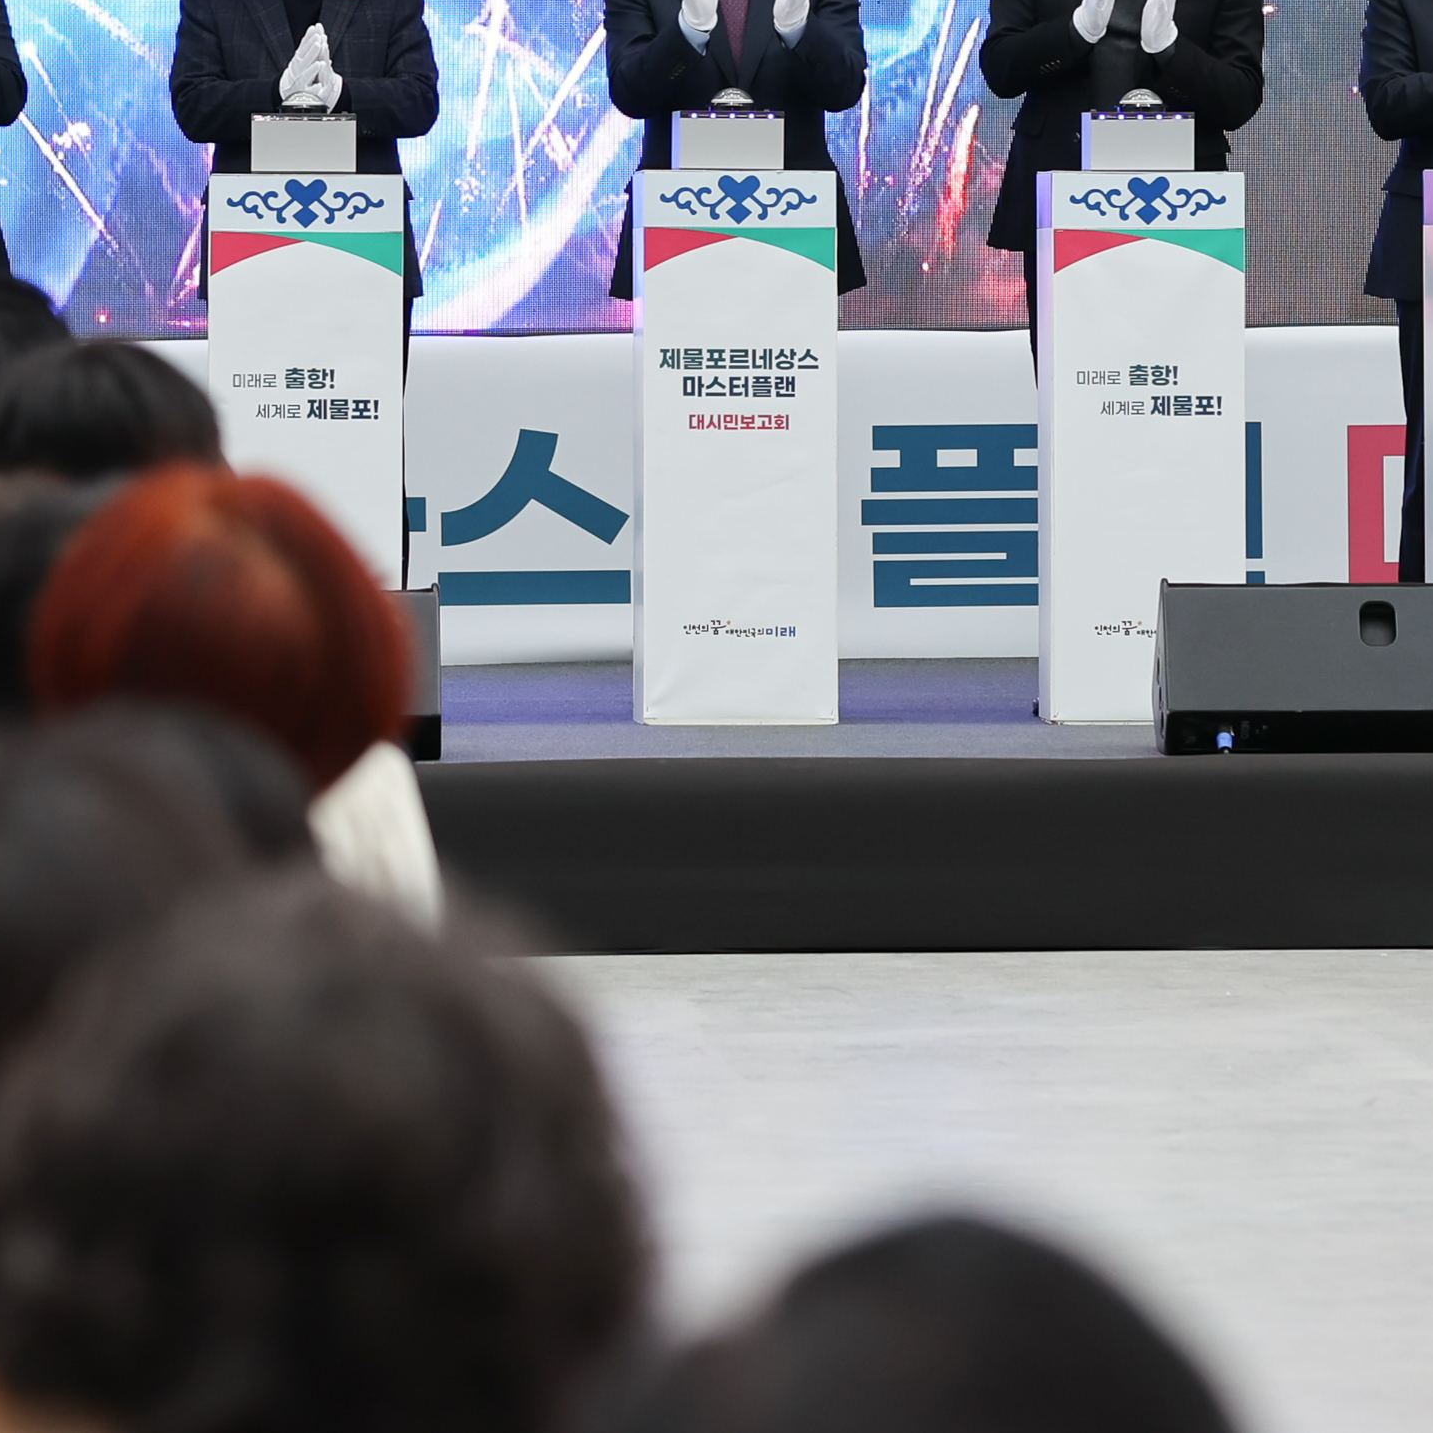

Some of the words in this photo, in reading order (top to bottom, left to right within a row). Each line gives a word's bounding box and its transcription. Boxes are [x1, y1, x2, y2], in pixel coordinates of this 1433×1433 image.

[659, 348, 819, 370] 제물포르네상스
[232, 373, 278, 389] 미래로
[284, 367, 336, 390] 출항!
[1076, 370, 1122, 386] 미래로
[1128, 364, 1179, 386] 출항!
[682, 375, 796, 398] 마스터플랜
[255, 404, 301, 419] 세계로
[306, 398, 380, 420] 제물포!
[1100, 400, 1146, 416] 세계로
[1150, 395, 1223, 416] 제물포!
[688, 414, 790, 431] 대시민보고회
